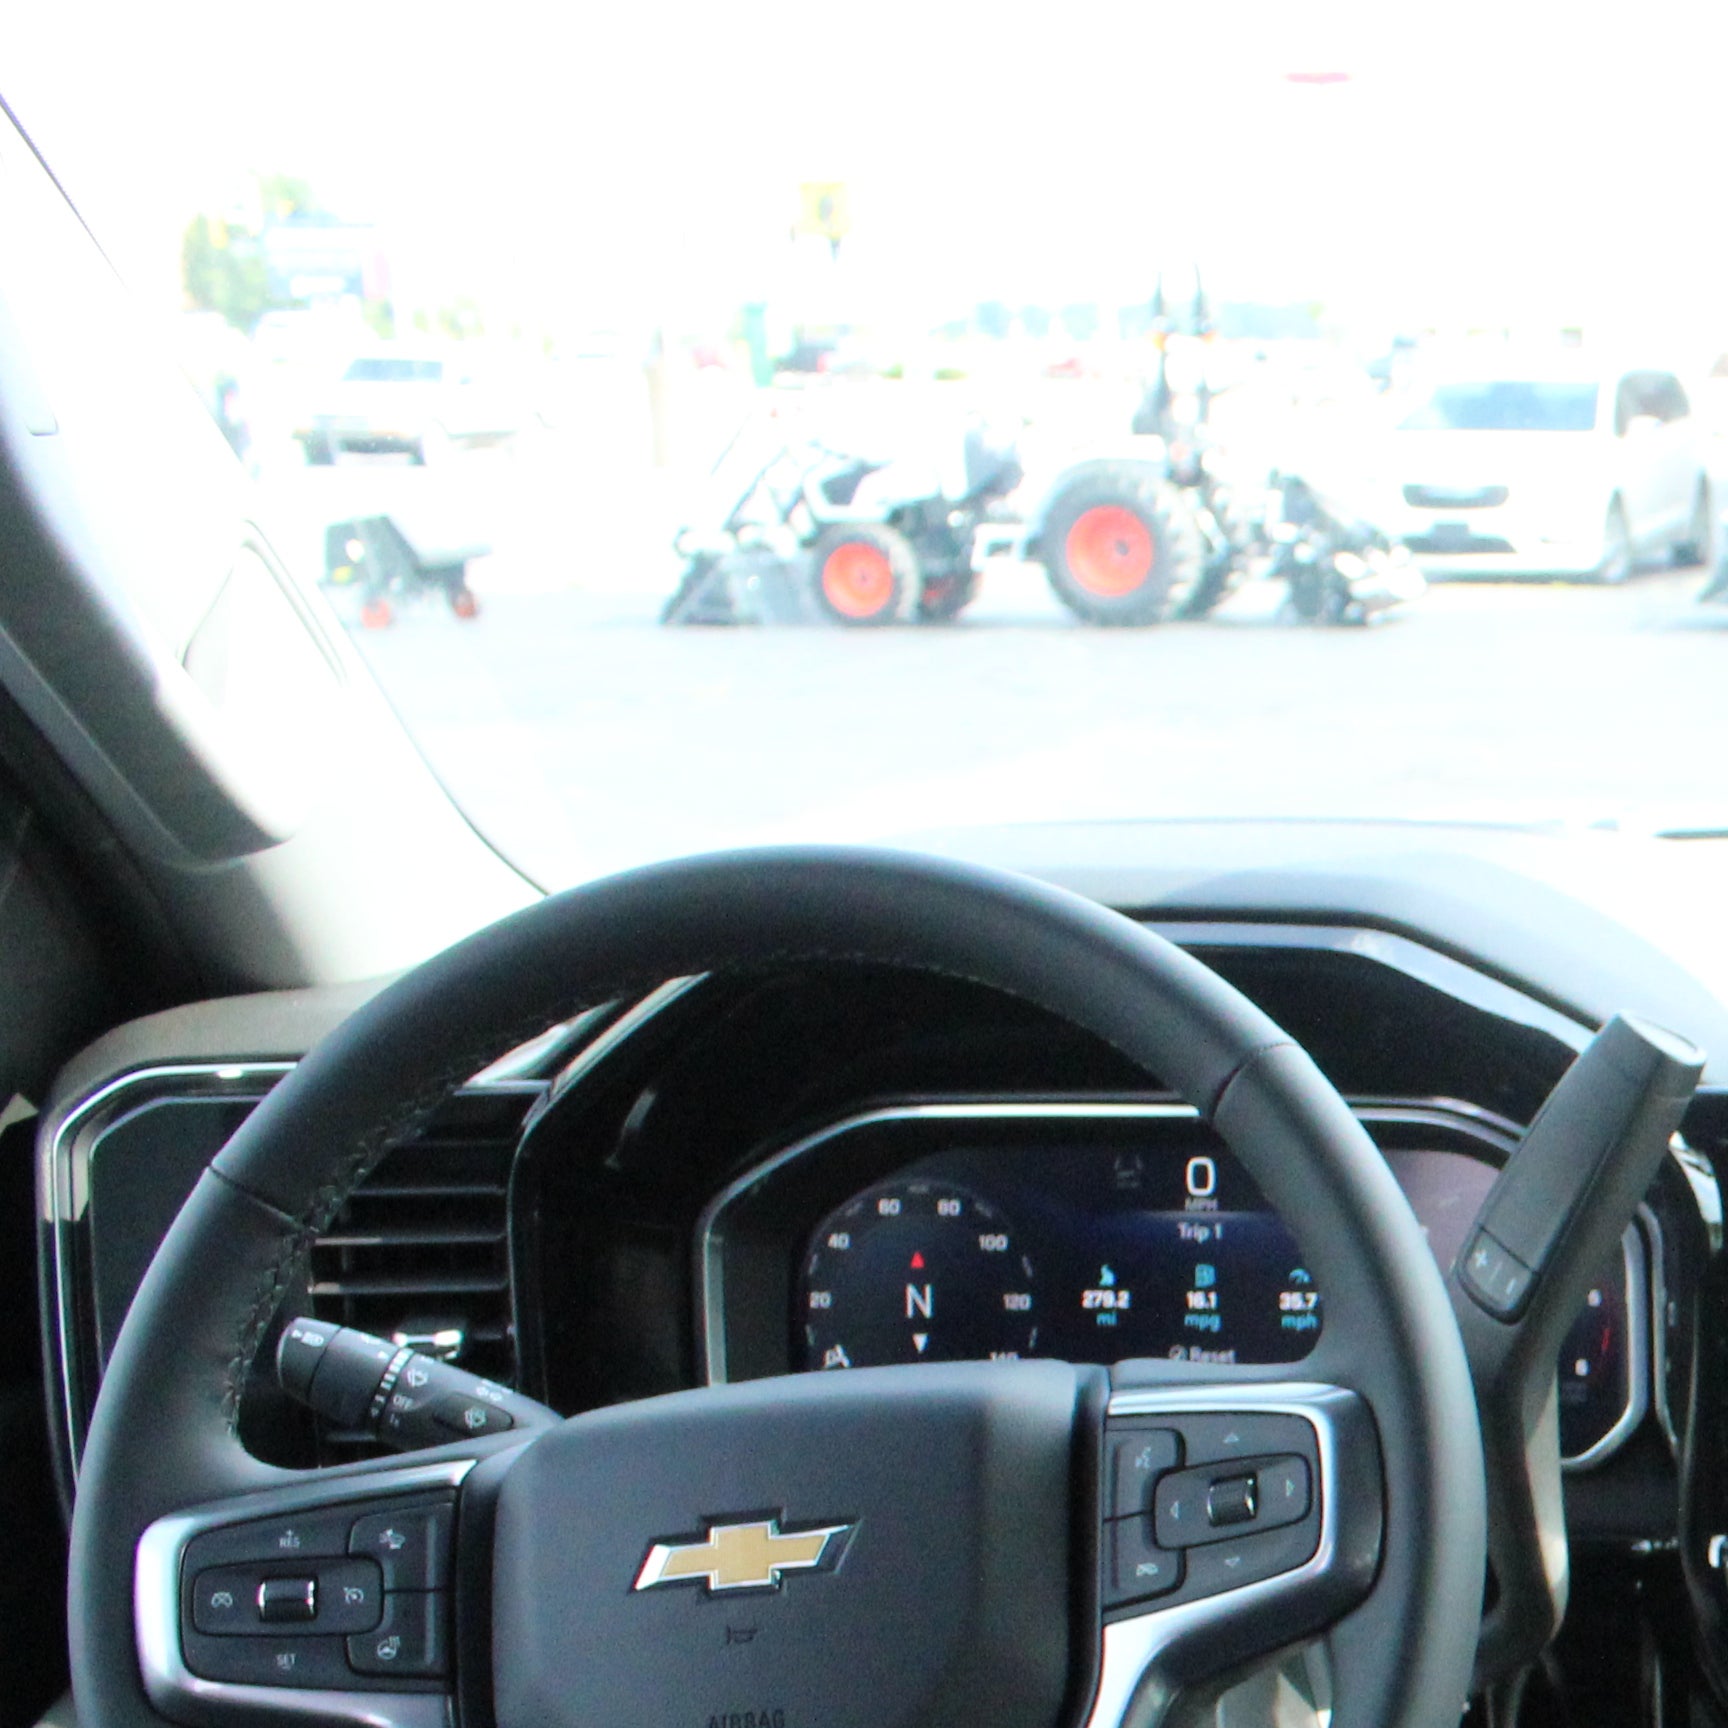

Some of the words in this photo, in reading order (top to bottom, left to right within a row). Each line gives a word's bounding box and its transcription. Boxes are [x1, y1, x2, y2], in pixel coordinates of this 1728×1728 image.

[1186, 1156, 1216, 1197] 0
[827, 1232, 851, 1250] 40
[979, 1233, 1009, 1252] 100
[1178, 1222, 1210, 1243] Trip
[1214, 1223, 1223, 1240] 1
[905, 1283, 934, 1319] N
[1184, 1314, 1221, 1333] mpg
